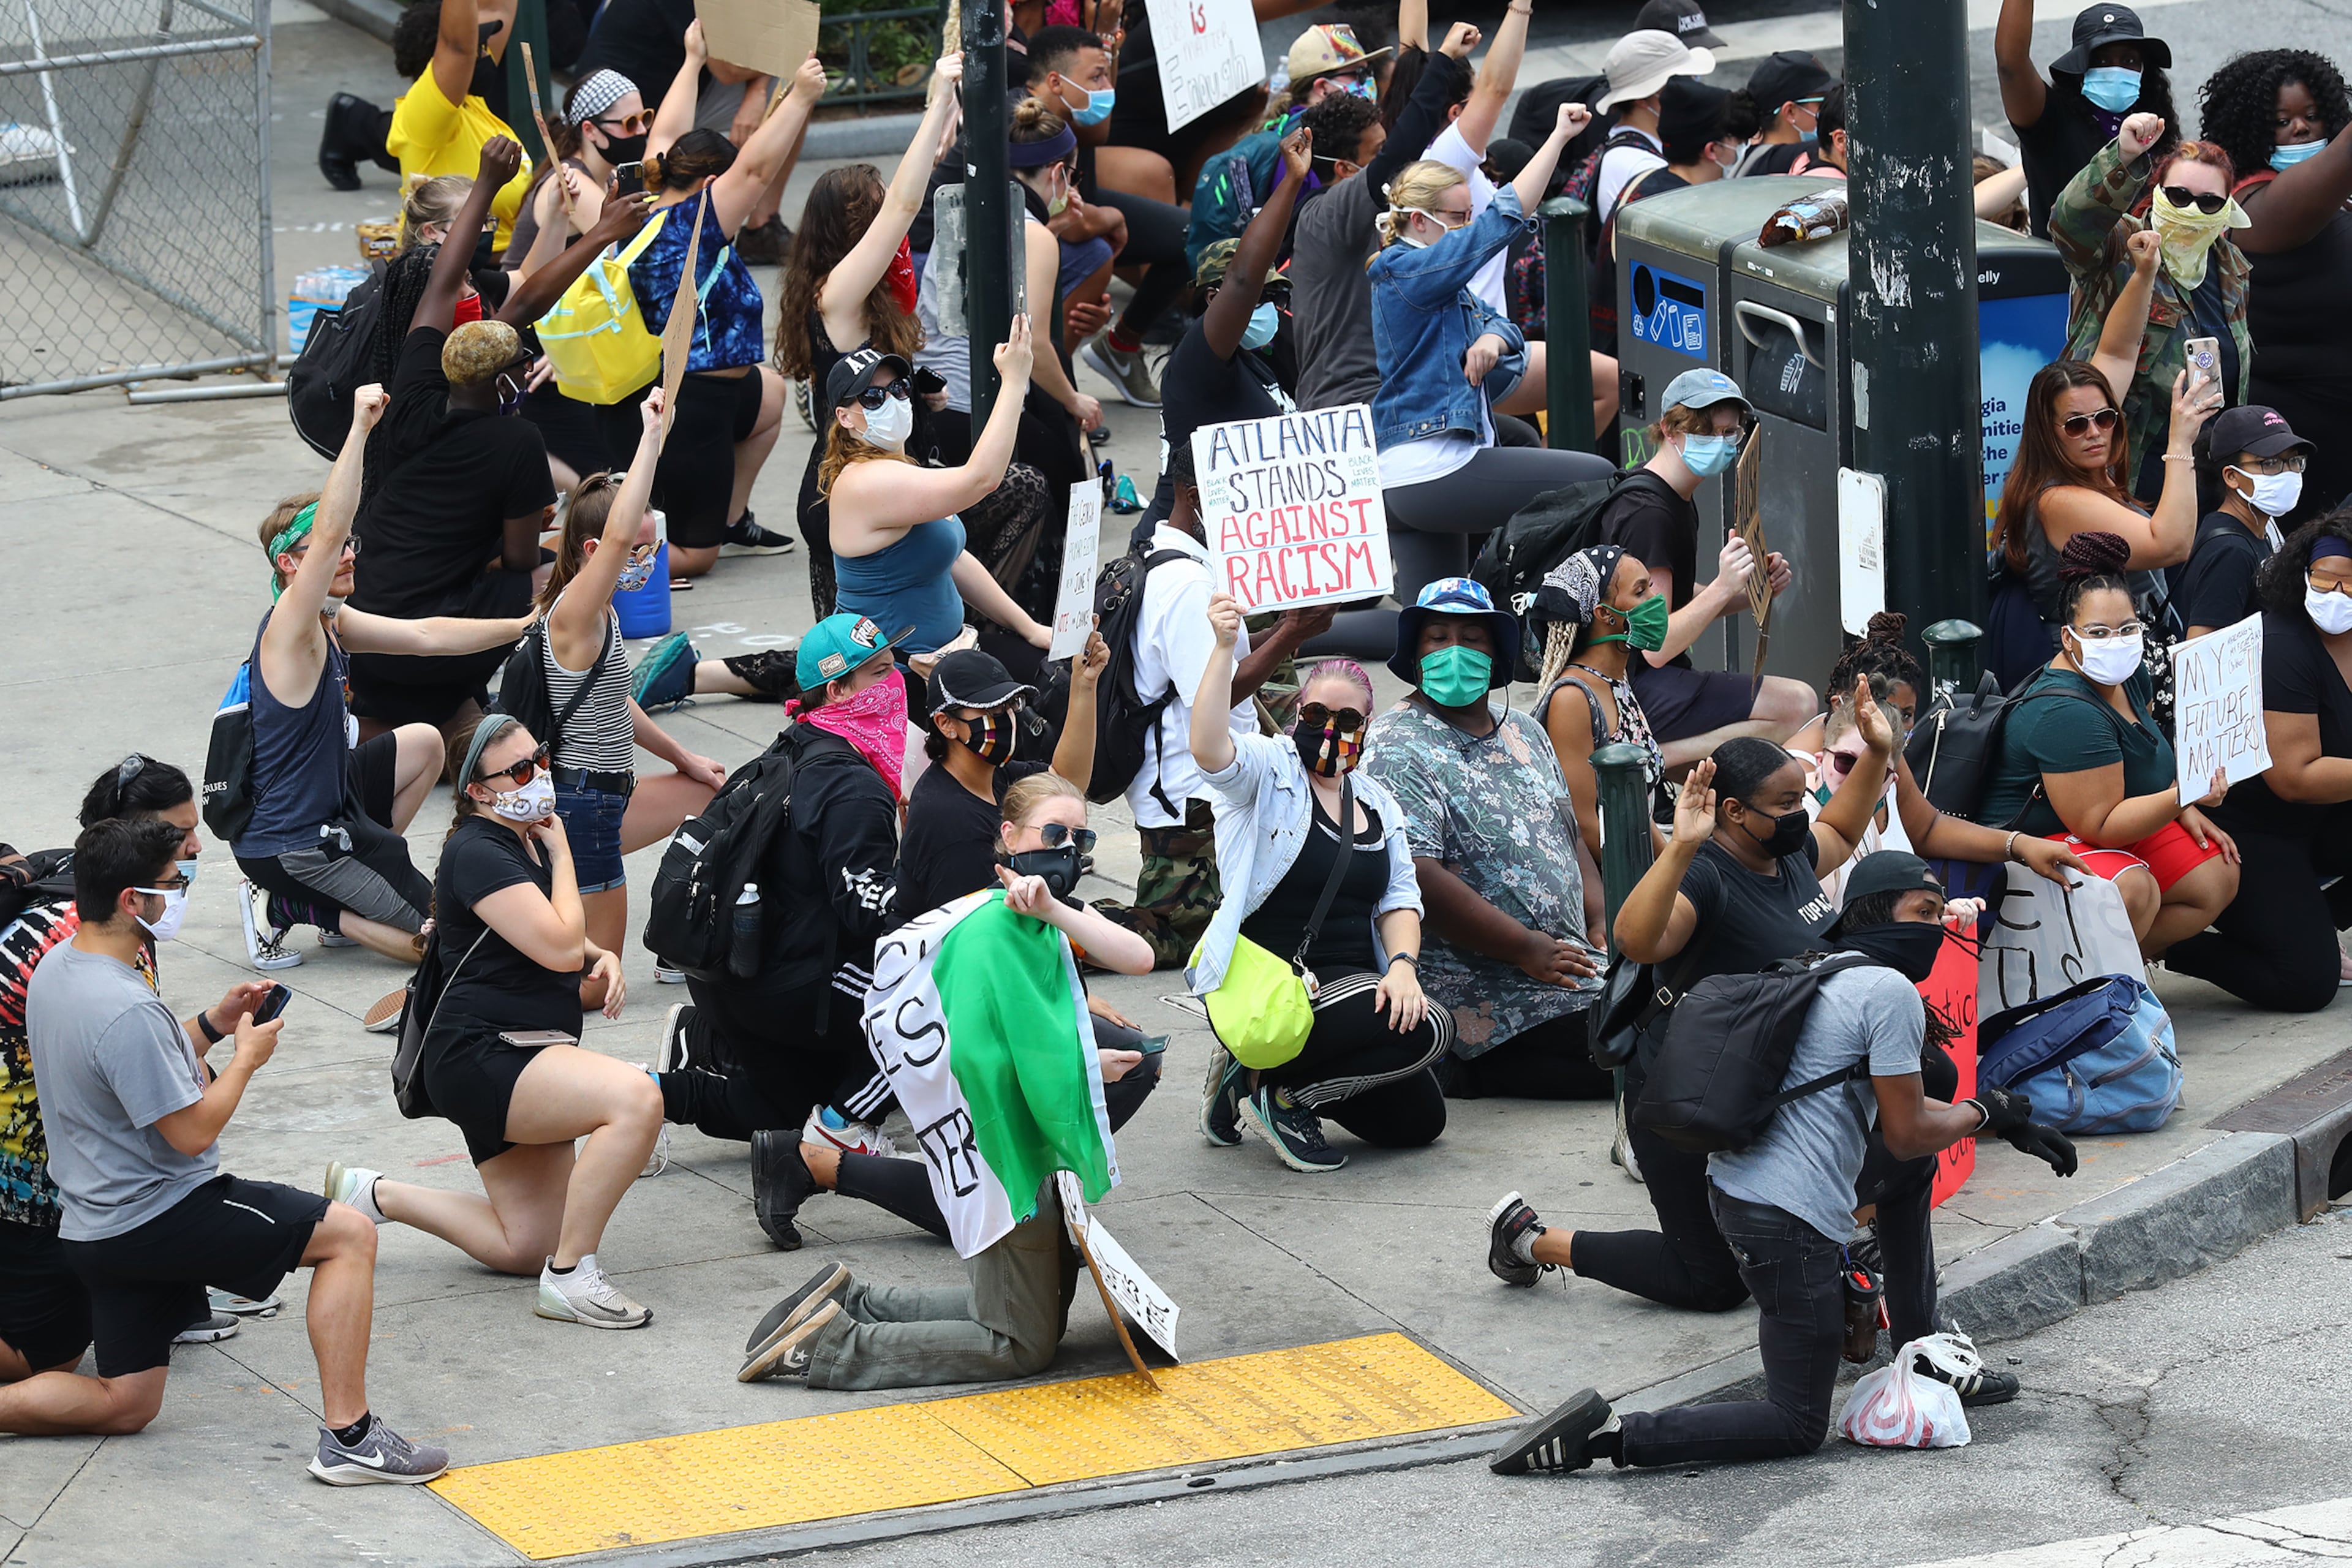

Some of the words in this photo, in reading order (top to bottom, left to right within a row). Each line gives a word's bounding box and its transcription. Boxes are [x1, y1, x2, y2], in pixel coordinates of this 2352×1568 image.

[1189, 1, 1206, 35] is
[1978, 270, 2000, 285] elly
[1982, 397, 2006, 417] gia
[1983, 420, 2024, 437] nitie
[1208, 409, 1371, 472] ATLANTA
[1348, 456, 1373, 468] BLACK
[1353, 467, 1374, 476] LIVES
[1207, 476, 1228, 487] BLACK
[1229, 460, 1346, 513] STANDS
[1351, 477, 1378, 488] MATTER
[1207, 489, 1226, 497] LIVES
[1209, 495, 1230, 507] MATTER
[1221, 499, 1372, 551] AGAINST
[1226, 541, 1376, 607] RACISM
[2183, 643, 2225, 697] MY
[2184, 685, 2249, 742] FUTURE
[2187, 715, 2259, 781] MATTERS
